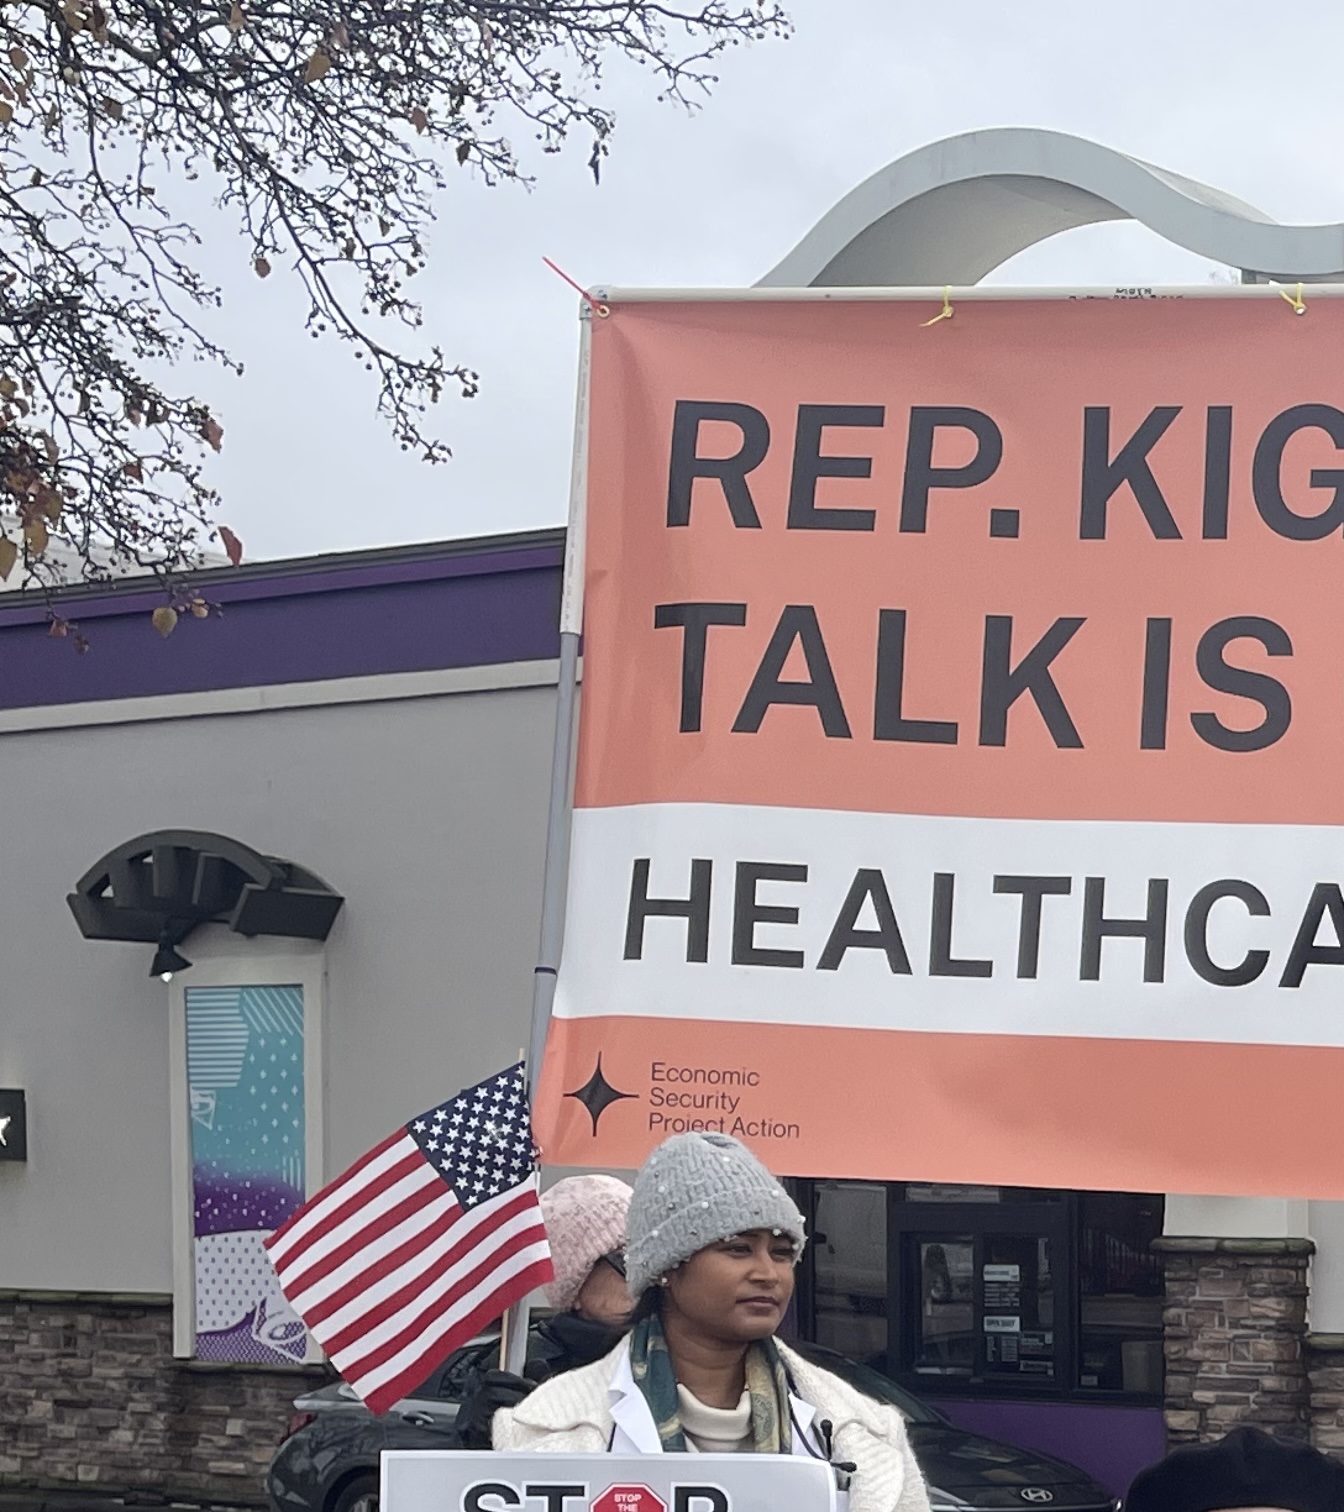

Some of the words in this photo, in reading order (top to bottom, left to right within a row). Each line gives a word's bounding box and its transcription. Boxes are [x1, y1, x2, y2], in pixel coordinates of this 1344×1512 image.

[666, 400, 1020, 538] REP.
[654, 602, 1088, 749] TALK
[1139, 615, 1294, 754] IS
[651, 1062, 761, 1087] Economic
[649, 1087, 741, 1114] Security
[729, 1118, 800, 1139] Action
[614, 1493, 642, 1503] STOP
[617, 1503, 638, 1512] THE
